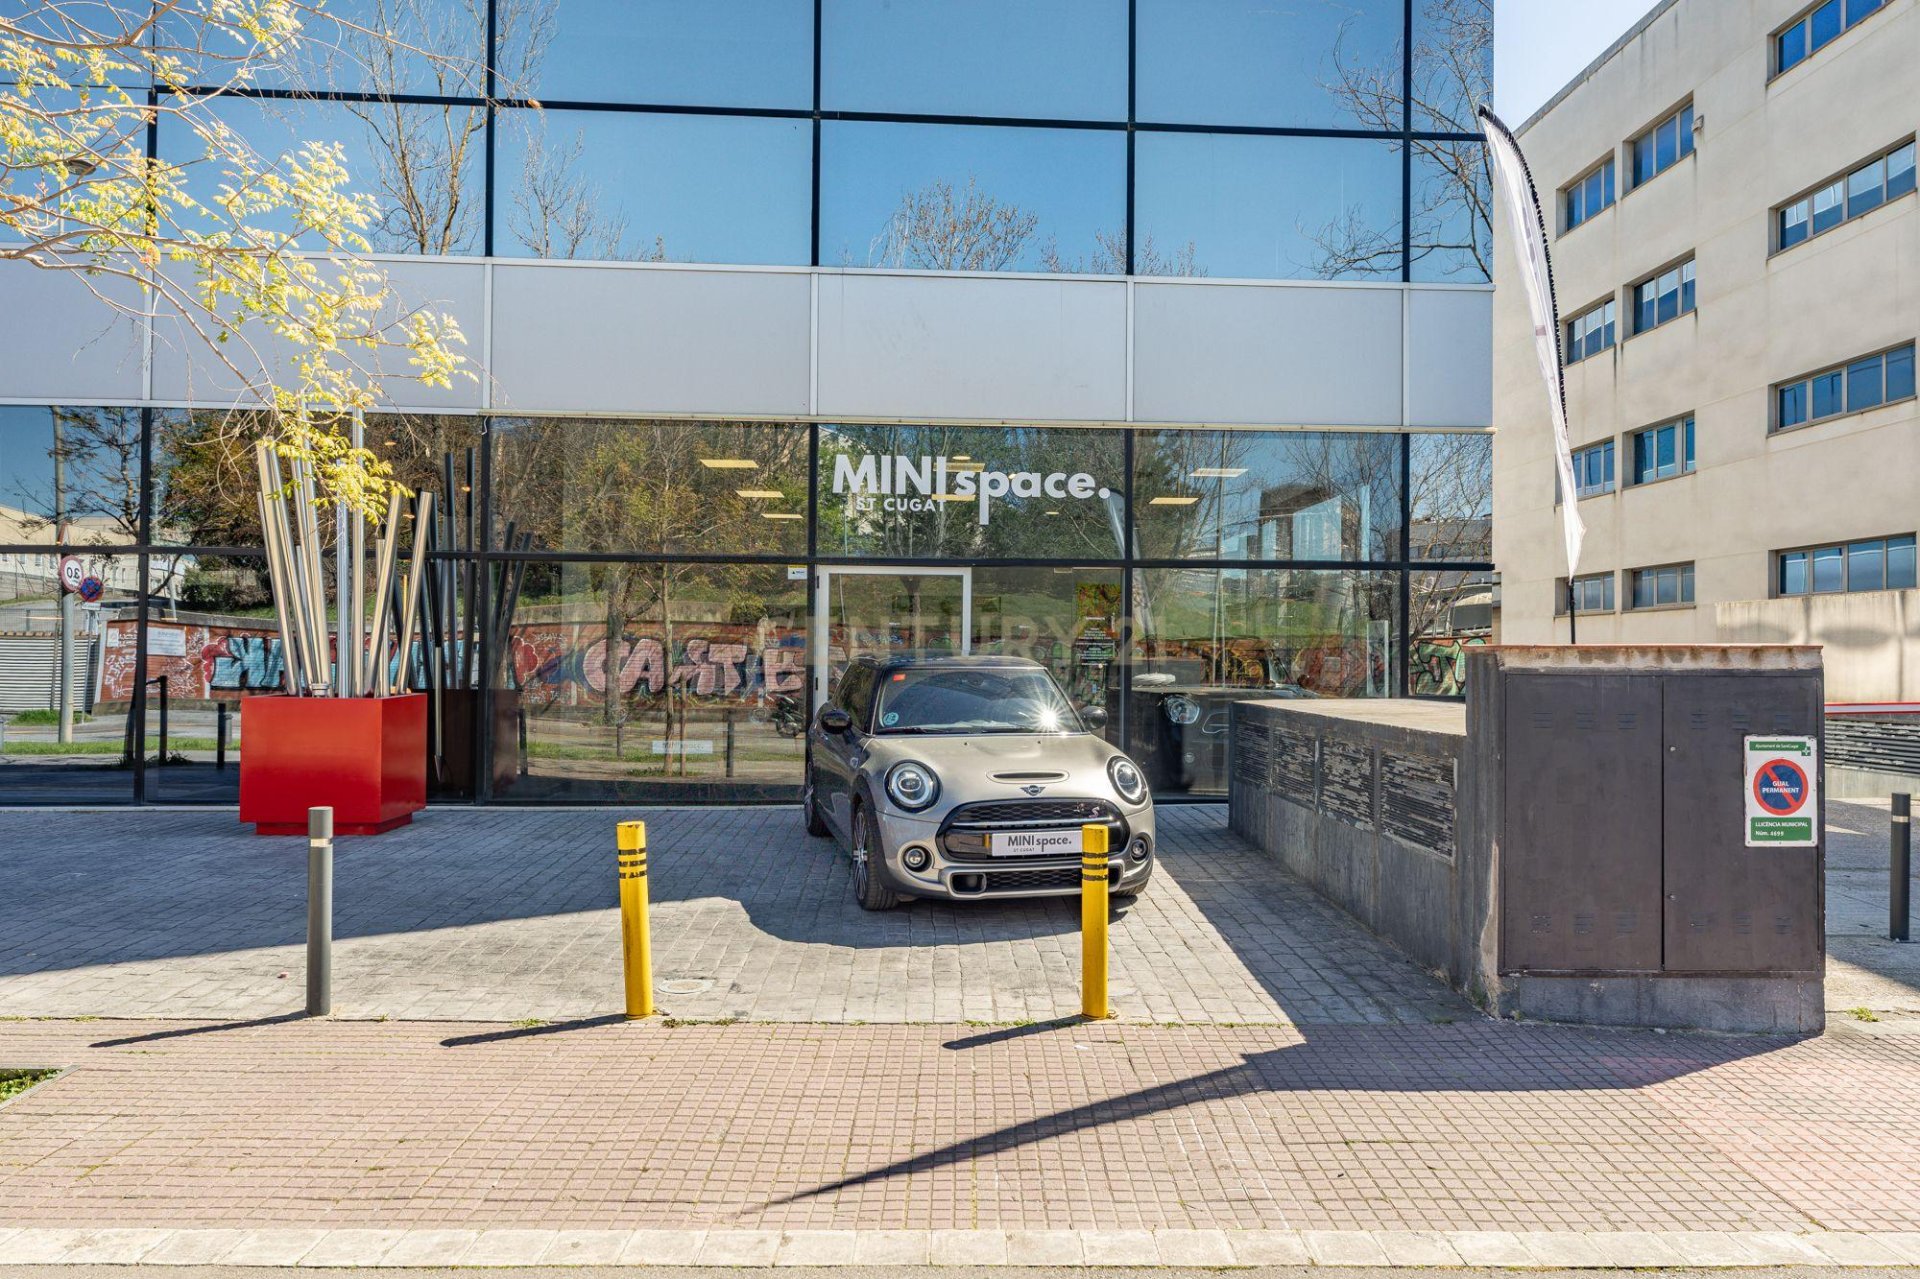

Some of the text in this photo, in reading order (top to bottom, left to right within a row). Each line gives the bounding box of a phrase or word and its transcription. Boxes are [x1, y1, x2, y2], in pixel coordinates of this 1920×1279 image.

[832, 454, 1111, 525] MINI space.
[855, 497, 947, 513] ST CUGAT
[1008, 835, 1072, 853] MINI space.
